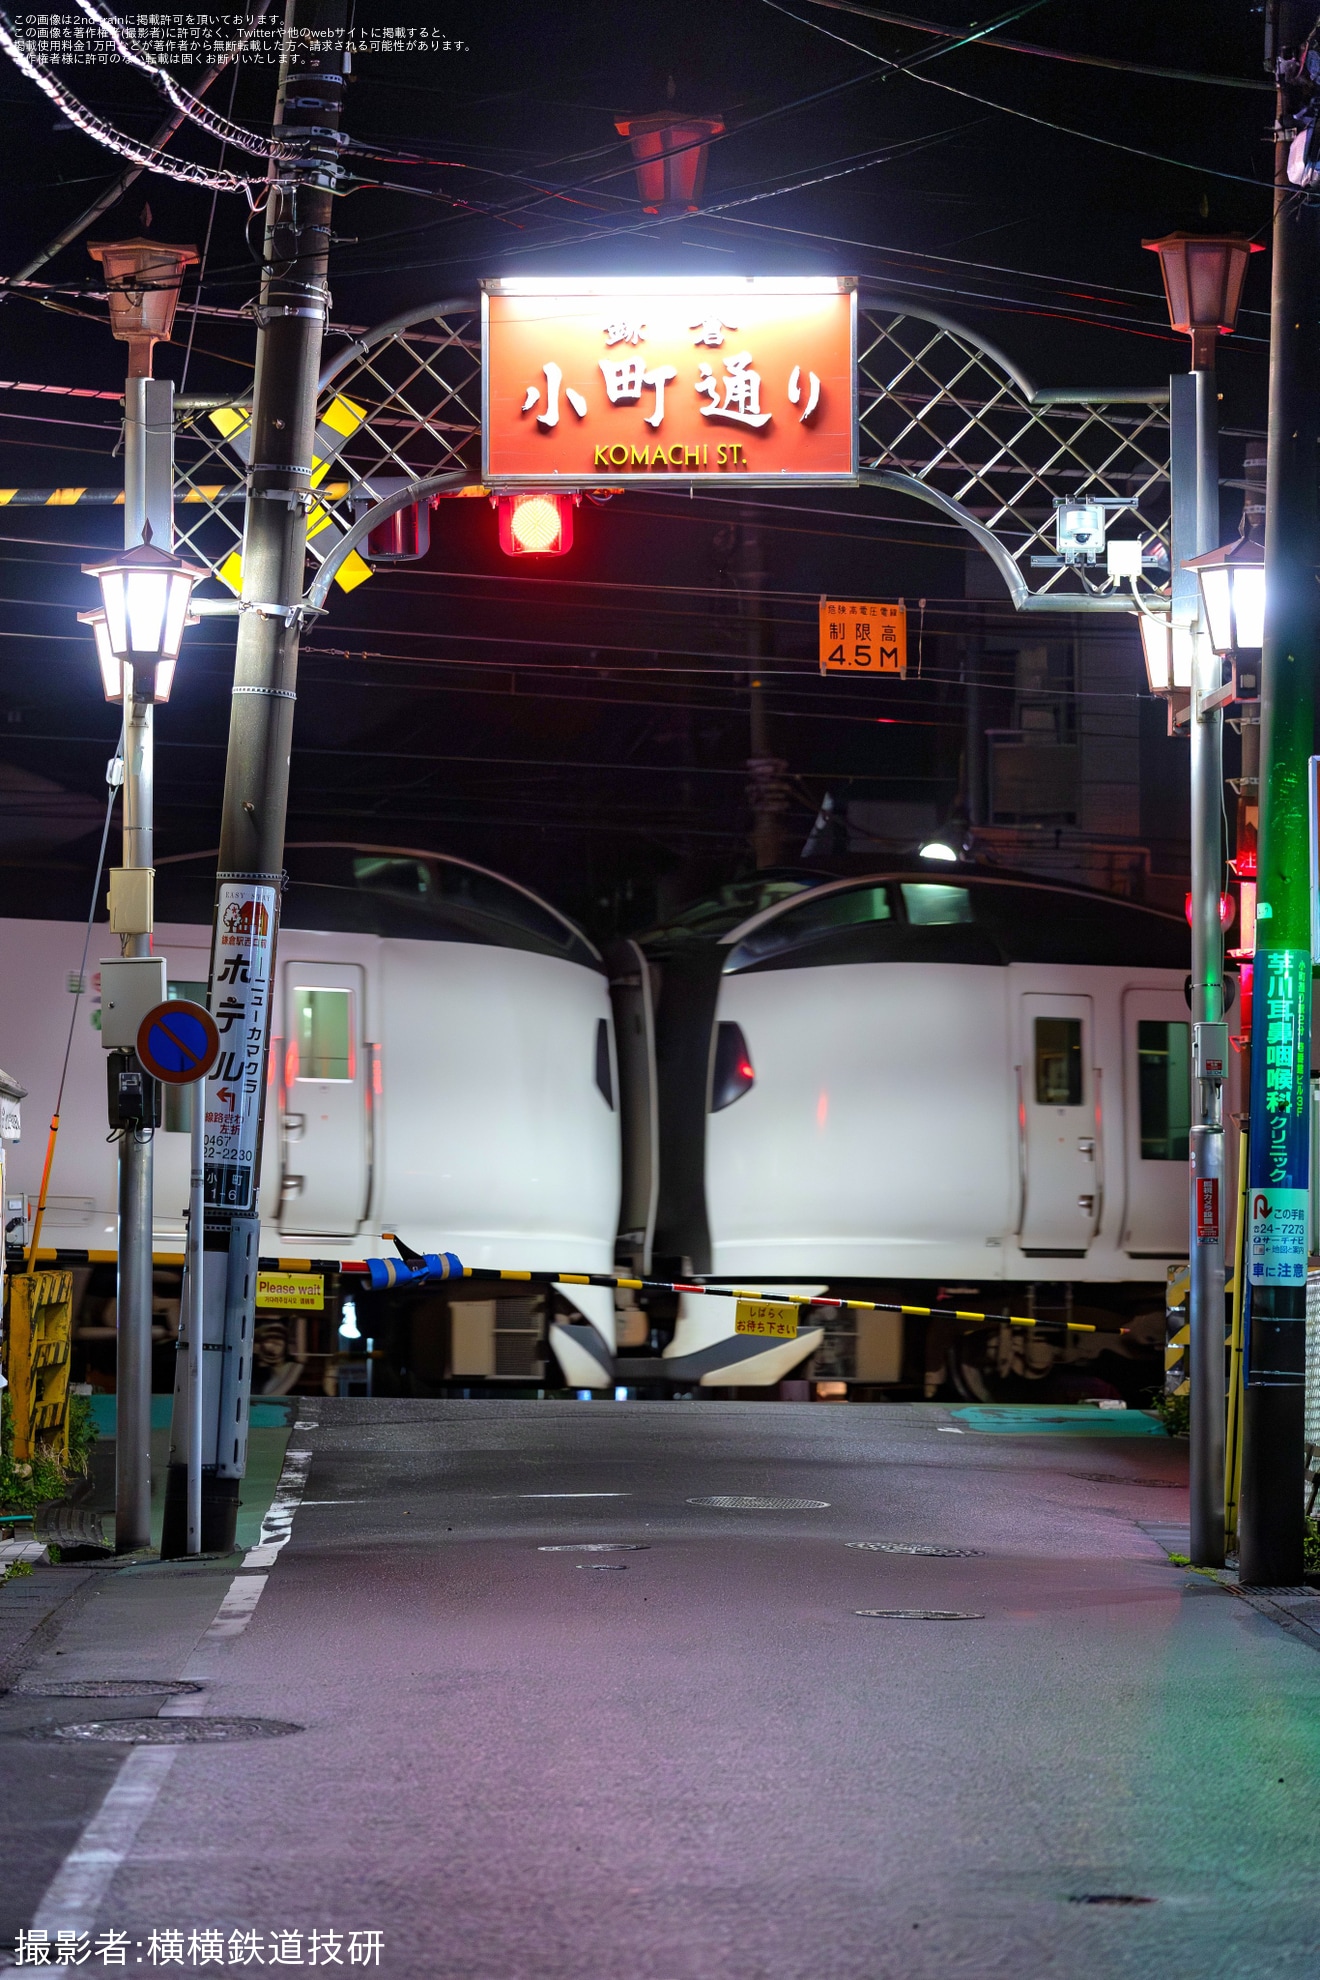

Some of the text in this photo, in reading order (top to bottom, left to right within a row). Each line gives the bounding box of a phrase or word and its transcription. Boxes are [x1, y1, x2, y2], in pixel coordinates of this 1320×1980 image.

[521, 351, 821, 428] 小町通り
[594, 444, 748, 466] KOMACHI ST.
[829, 622, 897, 643] 制限高
[225, 891, 246, 899] EASY
[208, 953, 251, 1082] ホテル
[205, 1111, 244, 1125] 線路きわ
[220, 1124, 240, 1135] 左折
[204, 1135, 231, 1147] 0467
[206, 1172, 243, 1186] 小町
[211, 1188, 237, 1201] 1-6
[1273, 1209, 1304, 1220] この手前
[1260, 1224, 1304, 1235] 24-7273
[1253, 1263, 1304, 1278] 車に注意
[259, 1281, 321, 1295] Please wait
[749, 1307, 784, 1319] しばらく
[737, 1321, 795, 1334] お待ち下さい
